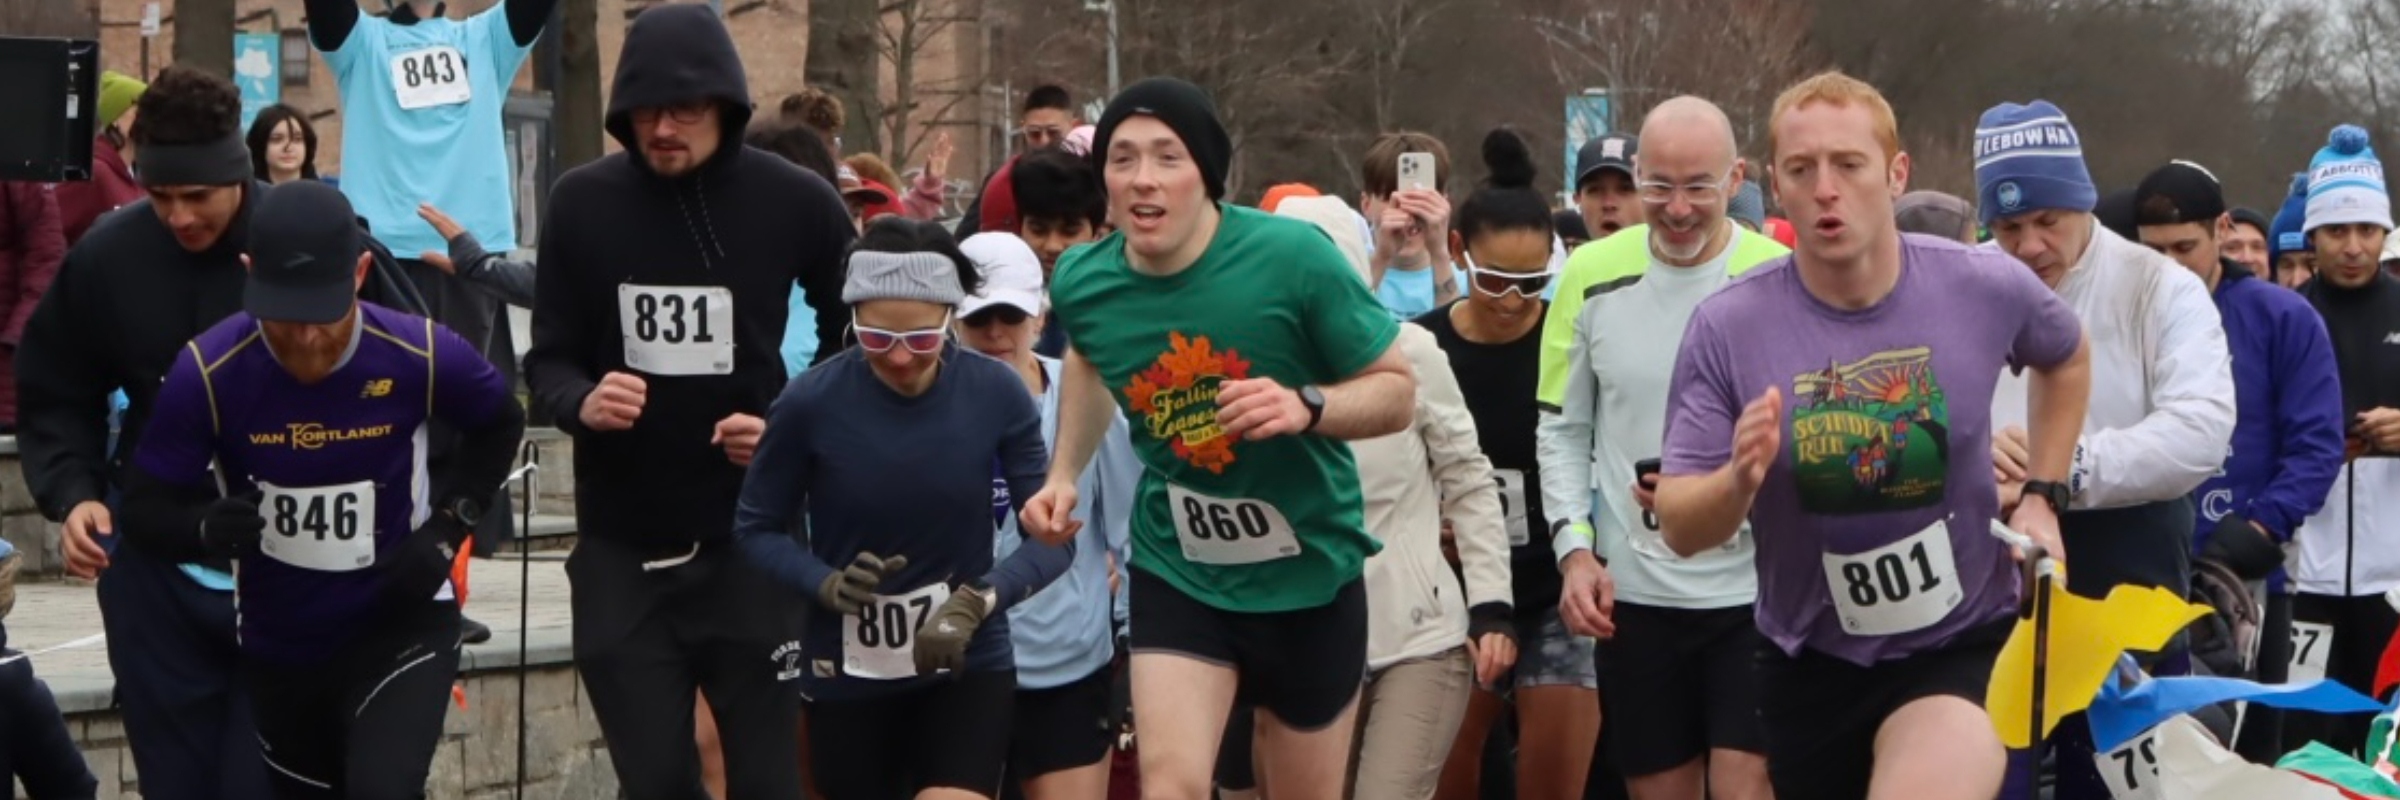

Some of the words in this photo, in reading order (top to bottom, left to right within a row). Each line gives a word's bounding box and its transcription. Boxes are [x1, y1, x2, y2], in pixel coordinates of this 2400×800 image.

[402, 52, 455, 88] 843
[1983, 126, 2043, 156] LEBOW
[635, 292, 714, 344] 831
[1150, 383, 1220, 420] Fallin
[249, 432, 285, 444] VAN
[1798, 432, 1846, 465] RUN
[274, 492, 359, 541] 846
[1183, 496, 1270, 542] 860
[1842, 540, 1942, 607] 801
[857, 595, 932, 649] 807
